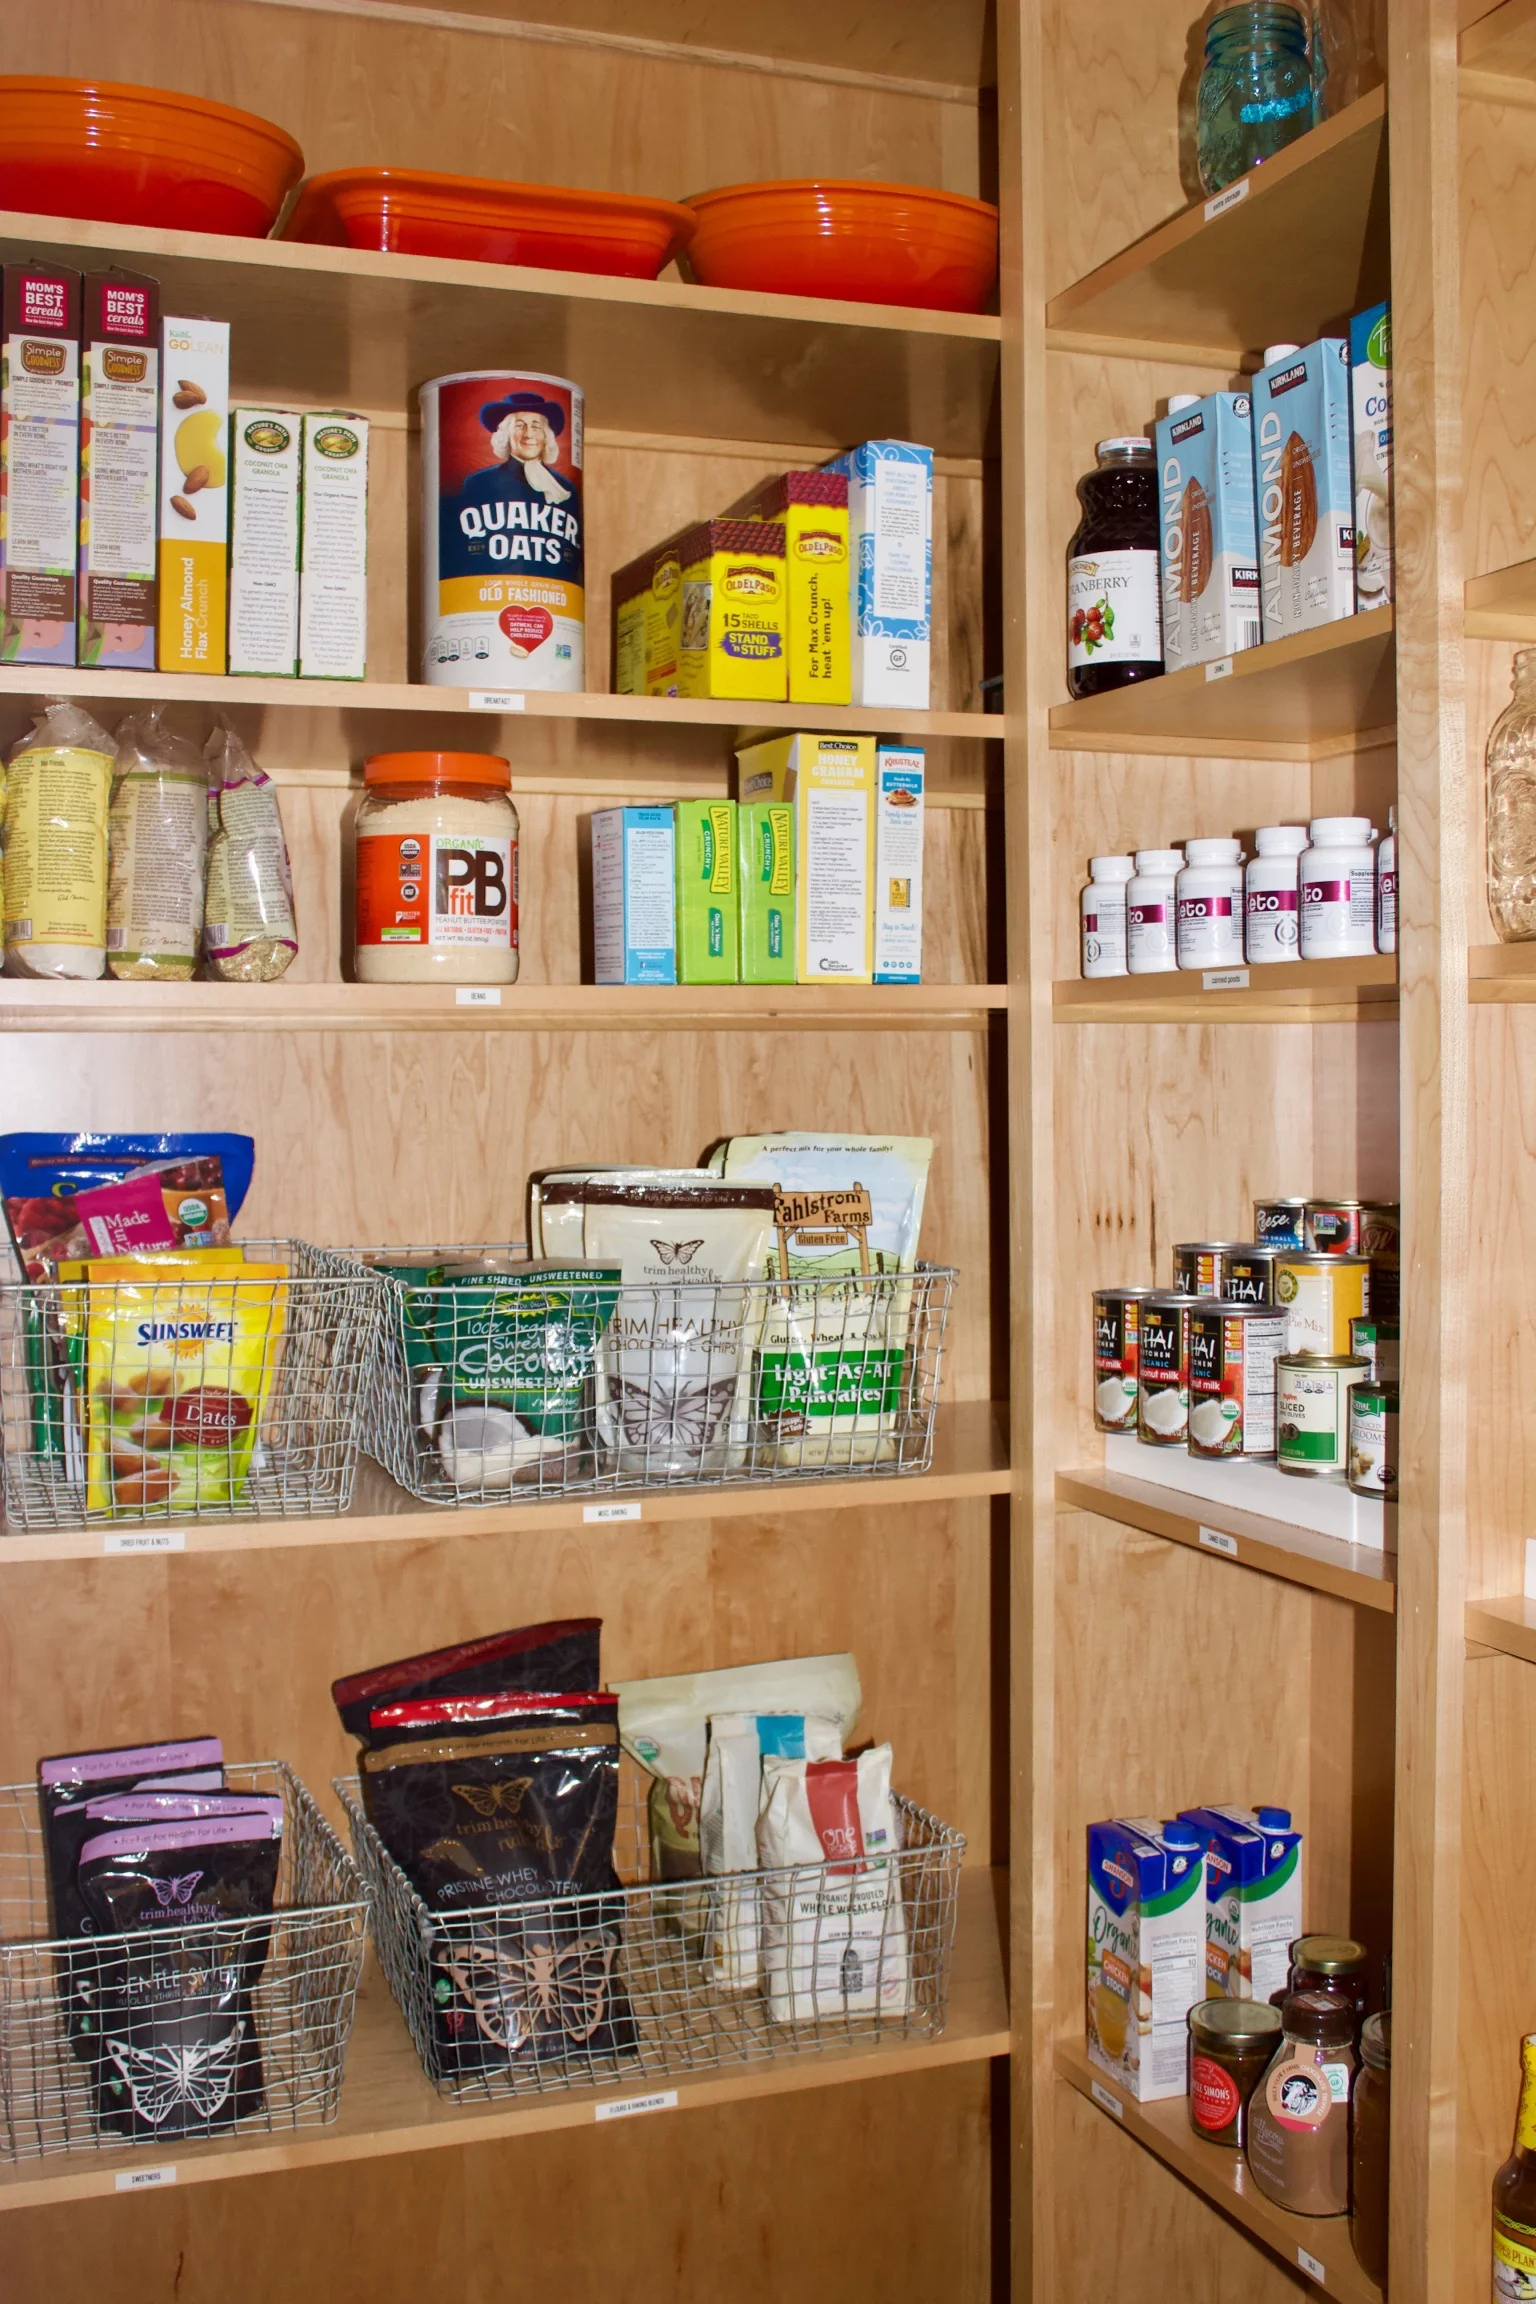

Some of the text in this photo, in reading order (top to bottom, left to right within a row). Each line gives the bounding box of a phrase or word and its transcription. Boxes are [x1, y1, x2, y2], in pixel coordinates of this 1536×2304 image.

[26, 281, 63, 294] MOM'S
[26, 292, 63, 307] BEST
[107, 290, 144, 302] MOM'S
[26, 306, 63, 318] cereals
[107, 301, 144, 315] BEST
[107, 314, 144, 325] cereals
[27, 343, 60, 357] Simple
[108, 351, 142, 364] Simple
[1271, 366, 1305, 389] KIRKLAND
[1172, 415, 1202, 437] KIRKLAND
[245, 460, 273, 469] COCONUT
[314, 465, 344, 474] COCONUT
[252, 468, 280, 477] GRANOLA
[322, 473, 350, 482] GRANOLA
[459, 501, 578, 547] QUAKER
[1260, 411, 1283, 624] ALMOND
[488, 534, 562, 564] OATS
[798, 540, 843, 555] OLD EL PASO
[1292, 489, 1302, 618] NON-DAIRY BEVERAGE
[1163, 457, 1183, 656] ALMOND
[726, 578, 776, 595] OLD EL PASO
[1190, 530, 1200, 652] NON-DAIRY BEVERAGE
[479, 587, 567, 606] OLD FASHIONED
[180, 557, 195, 658] Honey Almond
[822, 597, 834, 632] up!
[195, 579, 209, 659] Flax Crunch
[723, 613, 740, 628] 15
[742, 619, 778, 631] SHELLS
[729, 633, 769, 646] STAND
[809, 634, 820, 658] Max
[740, 644, 777, 657] STUFF
[809, 663, 820, 679] For
[822, 656, 832, 679] heat
[484, 696, 511, 705] BREAKFAST
[834, 742, 858, 751] Choice
[818, 754, 858, 766] HONEY
[884, 757, 920, 768] KRUSTEAZ
[812, 766, 864, 778] GRAHAM
[436, 839, 484, 850] ORGANIC
[713, 810, 729, 890] NATURE VALLEY
[773, 813, 788, 893] NATURE VALLEY
[450, 888, 474, 915] fit
[1212, 975, 1241, 985] canned goods
[471, 992, 486, 1001] BEANS
[770, 1145, 797, 1153] perfect
[826, 1146, 842, 1154] your
[869, 1145, 893, 1153] family!
[183, 1204, 200, 1212] USDA
[105, 1211, 150, 1230] Made
[824, 1209, 870, 1223] Farms
[115, 1228, 127, 1242] in
[797, 1234, 846, 1244] Gluten Free
[530, 1271, 603, 1283] UNSWEETENED
[643, 1266, 666, 1275] trim
[668, 1265, 710, 1278] healthy
[487, 1276, 521, 1286] SHRED
[1225, 1278, 1264, 1301] THAI
[467, 1321, 503, 1335] 100%
[1289, 1315, 1325, 1334] Pie Mix
[137, 1322, 233, 1346] SUNSWEET
[1105, 1360, 1122, 1370] milk
[1160, 1370, 1179, 1380] milk
[1203, 1382, 1220, 1391] milk
[1280, 1403, 1305, 1412] SLICED
[186, 1405, 237, 1426] Dates
[1360, 1421, 1382, 1429] SLICED
[120, 1537, 169, 1547] DRIED FRUIT & NUTS
[456, 1820, 491, 1835] trim
[822, 1827, 855, 1846] one
[1104, 1861, 1134, 1888] SWANSON
[437, 1867, 538, 1901] PRISTINE WHEY
[140, 1903, 211, 1920] trim healthy
[800, 1902, 834, 1915] WHOLE
[1093, 1905, 1139, 1960] Organic
[1252, 1921, 1293, 1932] Nutrition Facts
[1152, 1937, 1197, 1948] Nutrition Facts
[1103, 1960, 1129, 1984] CHICKEN
[1153, 1958, 1197, 1972] Calories 10
[1106, 1976, 1126, 1997] STOCK
[1203, 2085, 1230, 2100] SIMON'S
[132, 2172, 161, 2184] SWEETNERS
